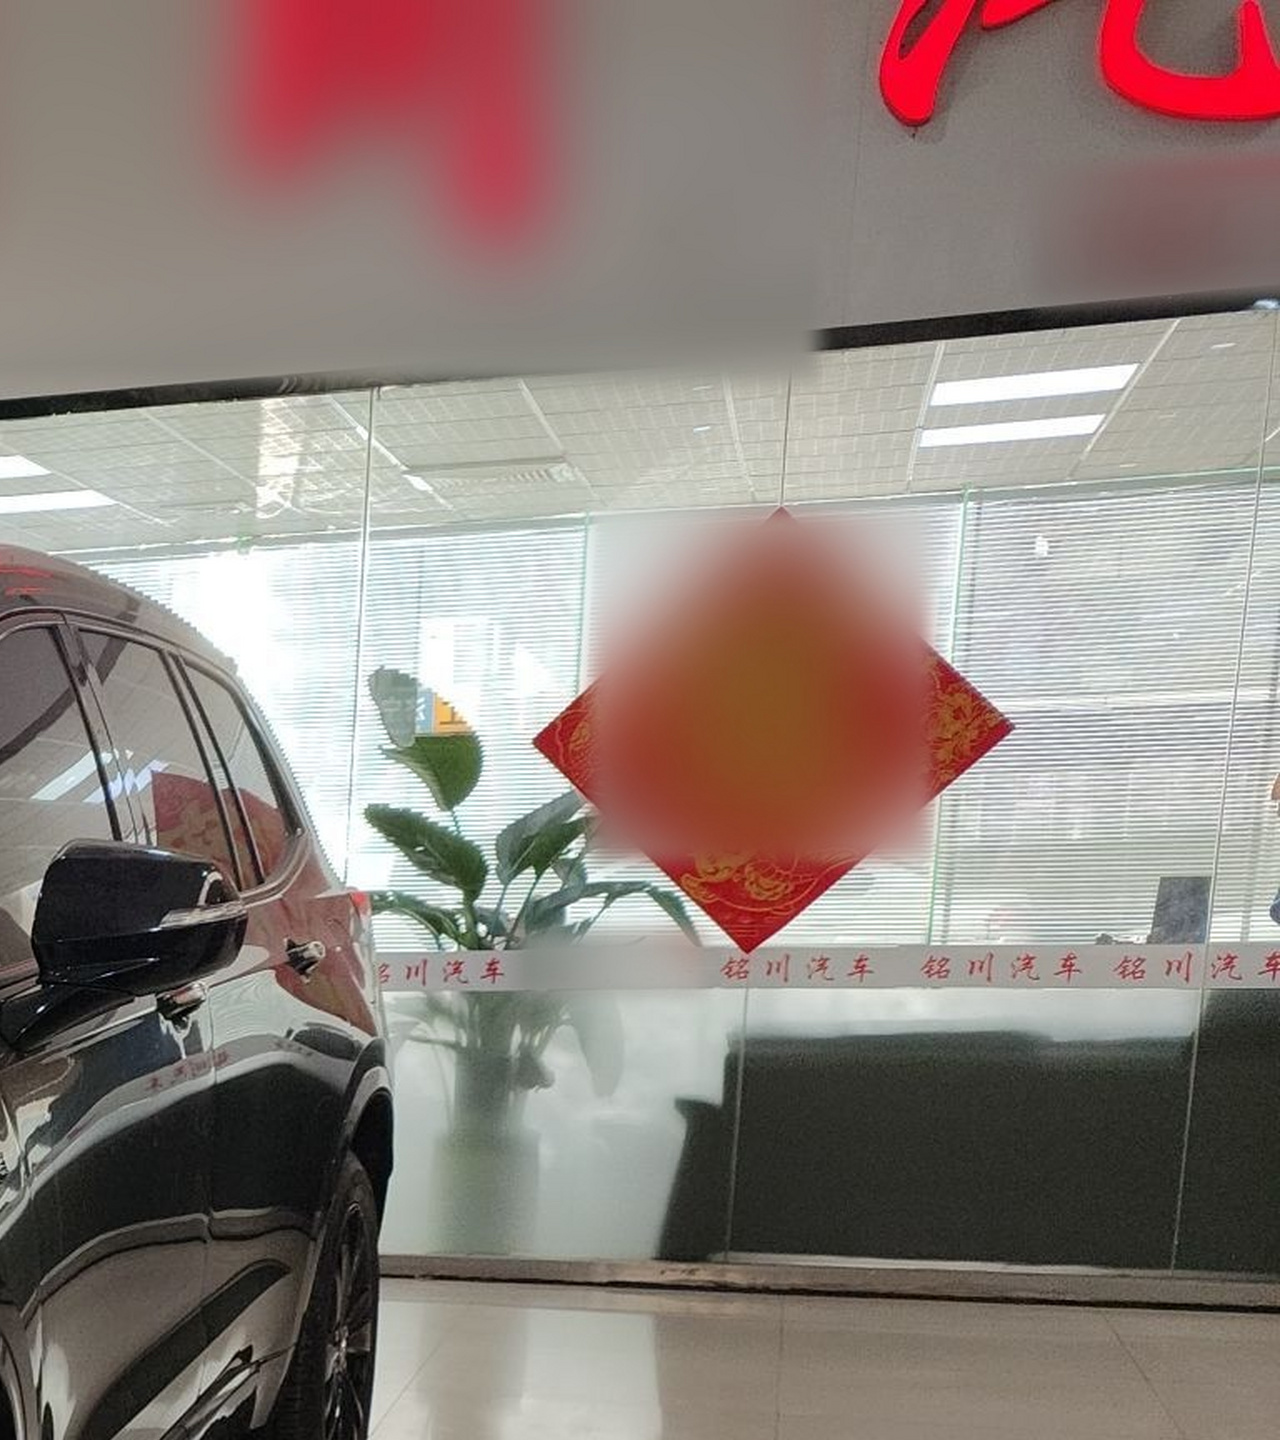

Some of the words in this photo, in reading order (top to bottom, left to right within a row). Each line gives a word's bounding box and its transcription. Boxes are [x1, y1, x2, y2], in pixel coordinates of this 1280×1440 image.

[720, 953, 875, 983] 铭川汽车
[919, 951, 1083, 983] 铭川汽车
